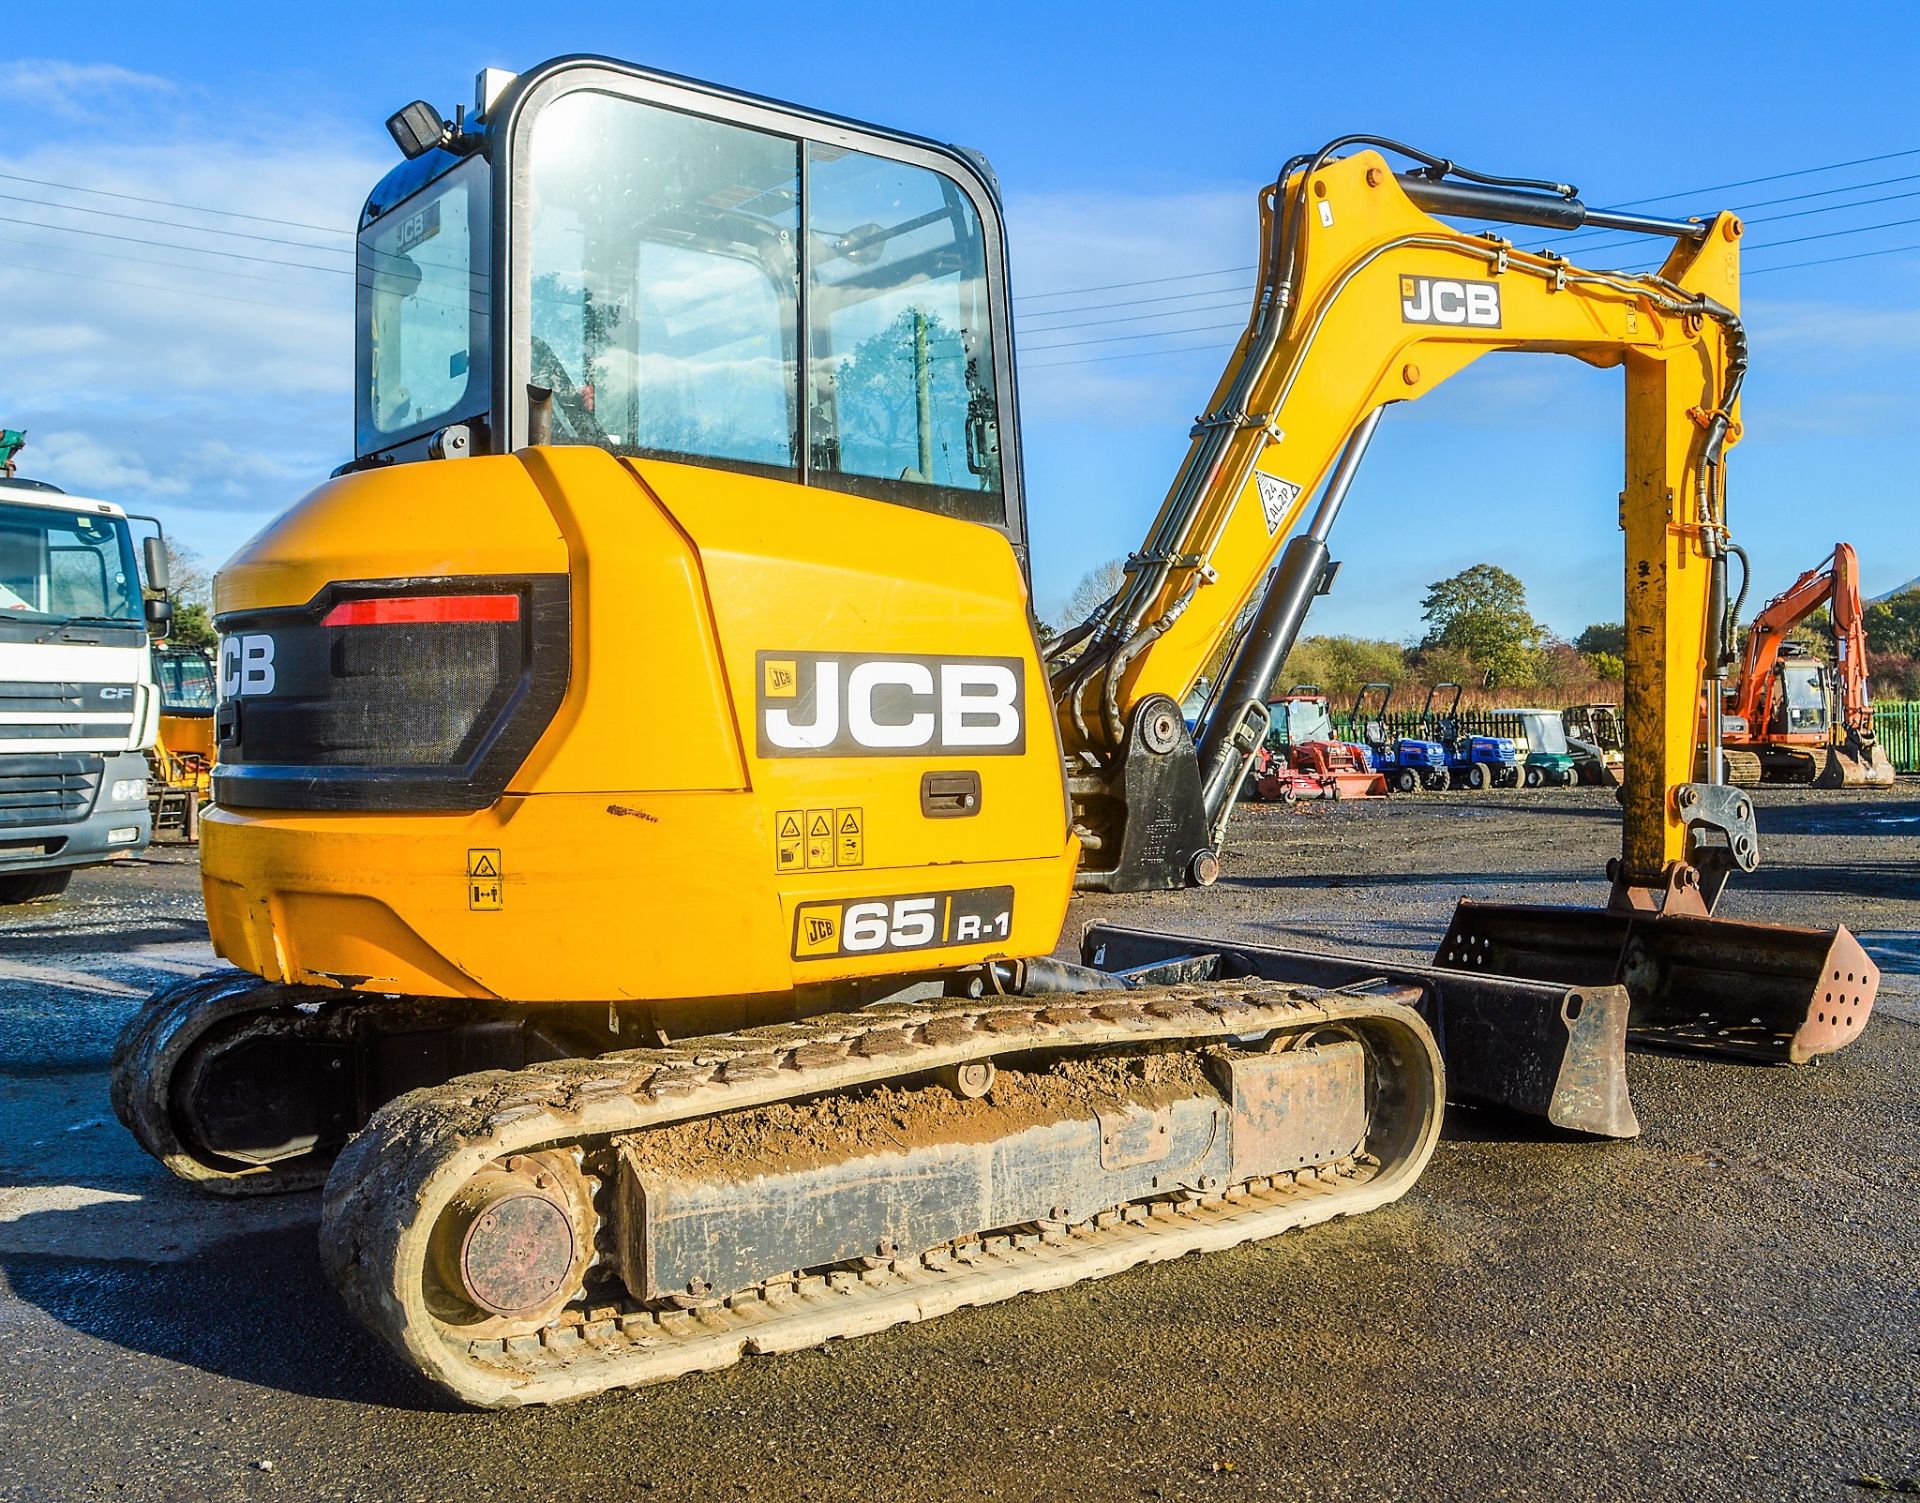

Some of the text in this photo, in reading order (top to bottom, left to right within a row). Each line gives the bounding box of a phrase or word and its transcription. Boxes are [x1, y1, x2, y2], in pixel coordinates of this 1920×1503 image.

[397, 213, 424, 248] JCB
[1403, 280, 1499, 325] JCB
[1264, 483, 1277, 501] 24
[222, 634, 276, 697] CB
[773, 670, 791, 687] JCB
[100, 687, 132, 700] CF
[765, 661, 1020, 749] JCB
[809, 920, 835, 943] JCB
[843, 897, 1009, 951] 65 R-1
